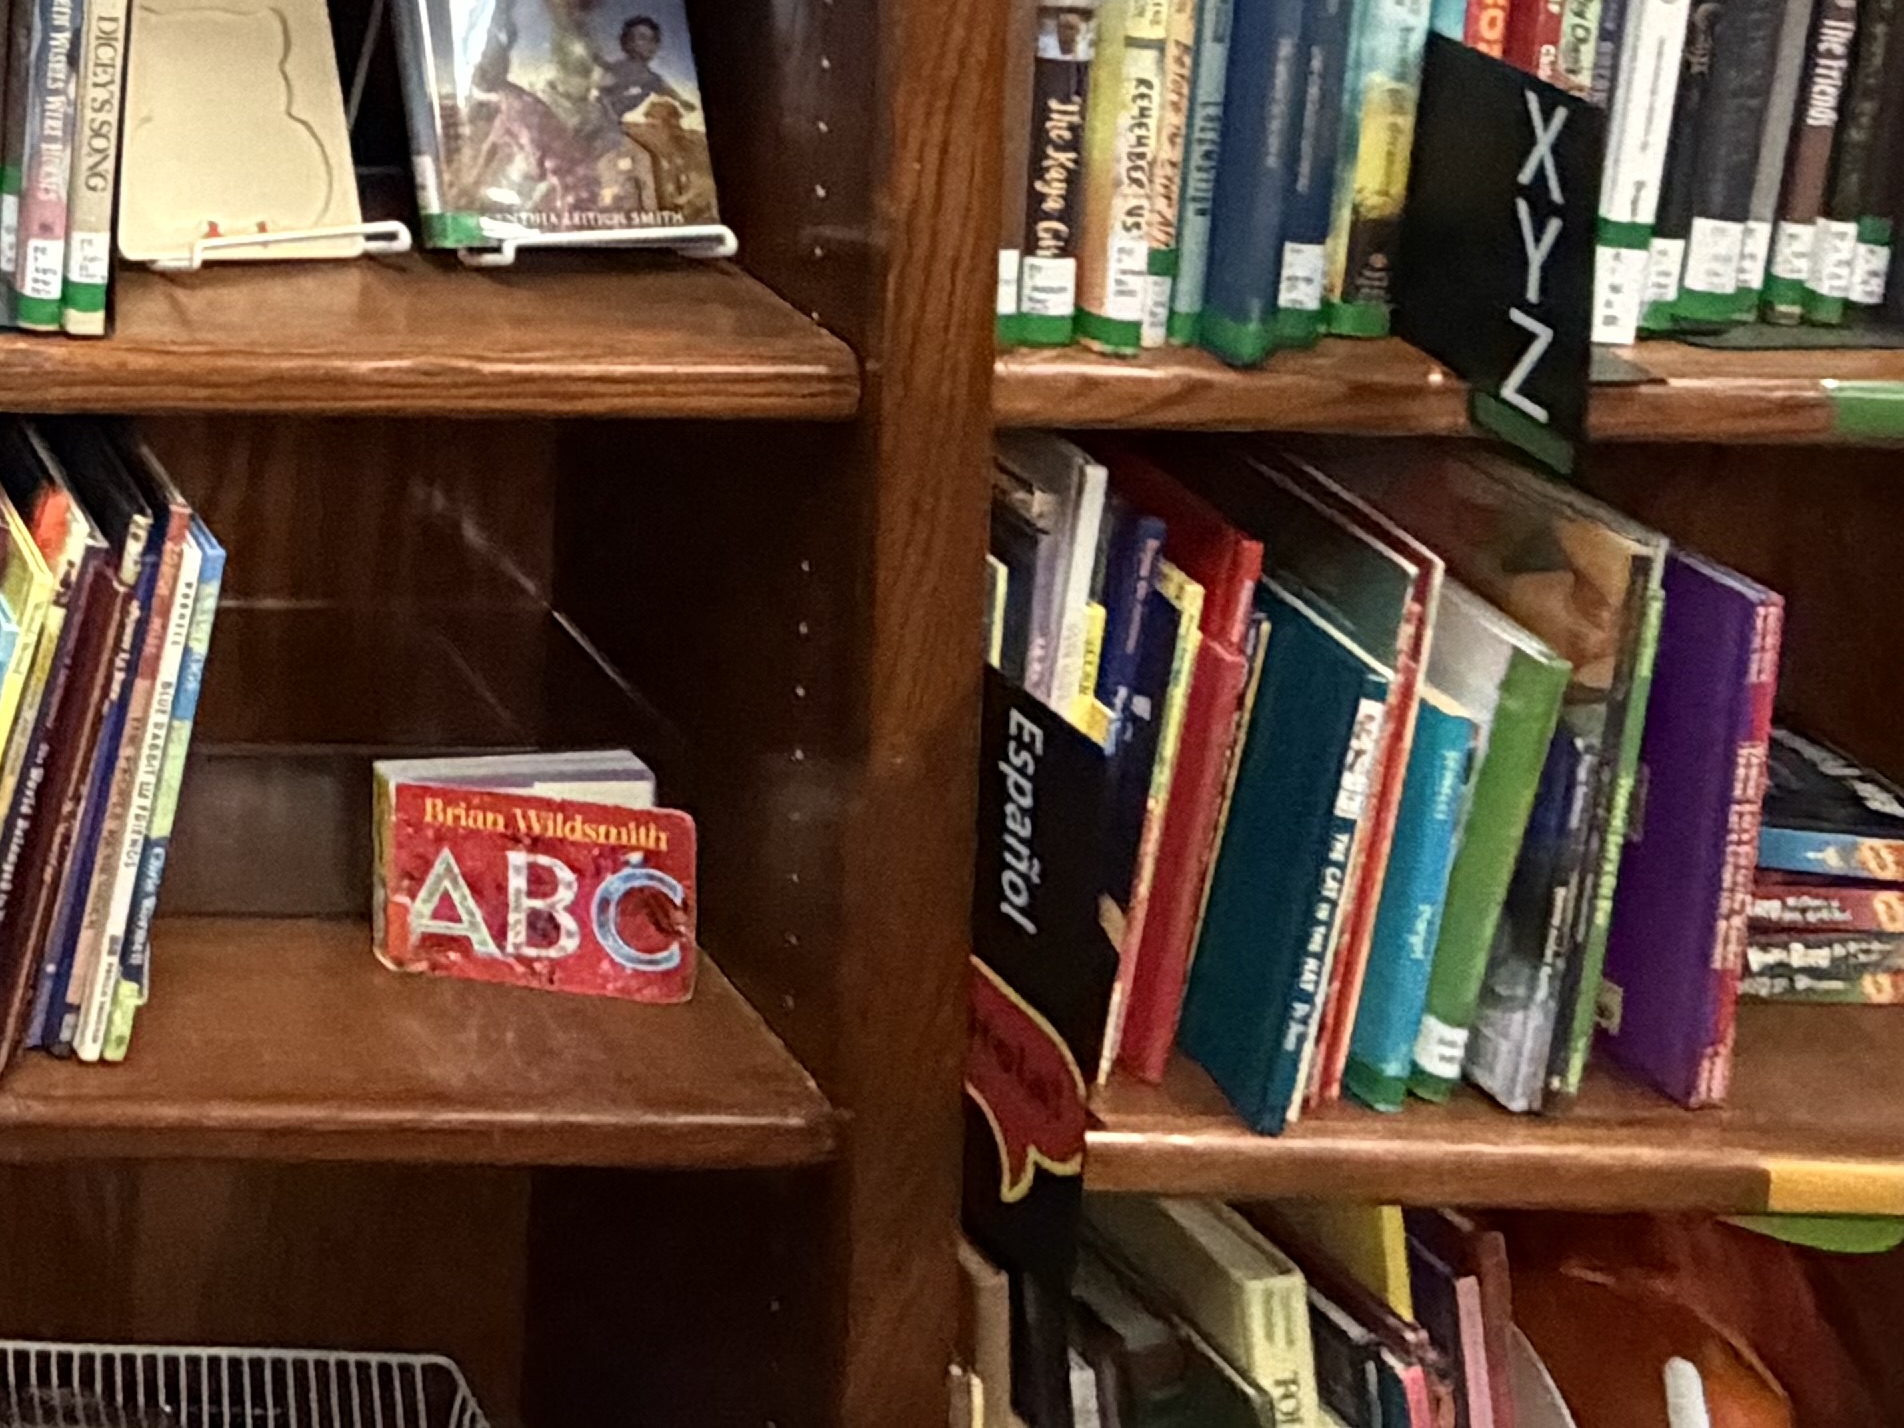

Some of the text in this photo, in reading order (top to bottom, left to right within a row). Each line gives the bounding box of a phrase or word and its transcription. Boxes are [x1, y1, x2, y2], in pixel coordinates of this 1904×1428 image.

[84, 15, 121, 193] DICEY'S SONG
[424, 796, 670, 853] Brian Wildsmith
[999, 705, 1046, 935] Español
[408, 847, 685, 972] ABC
